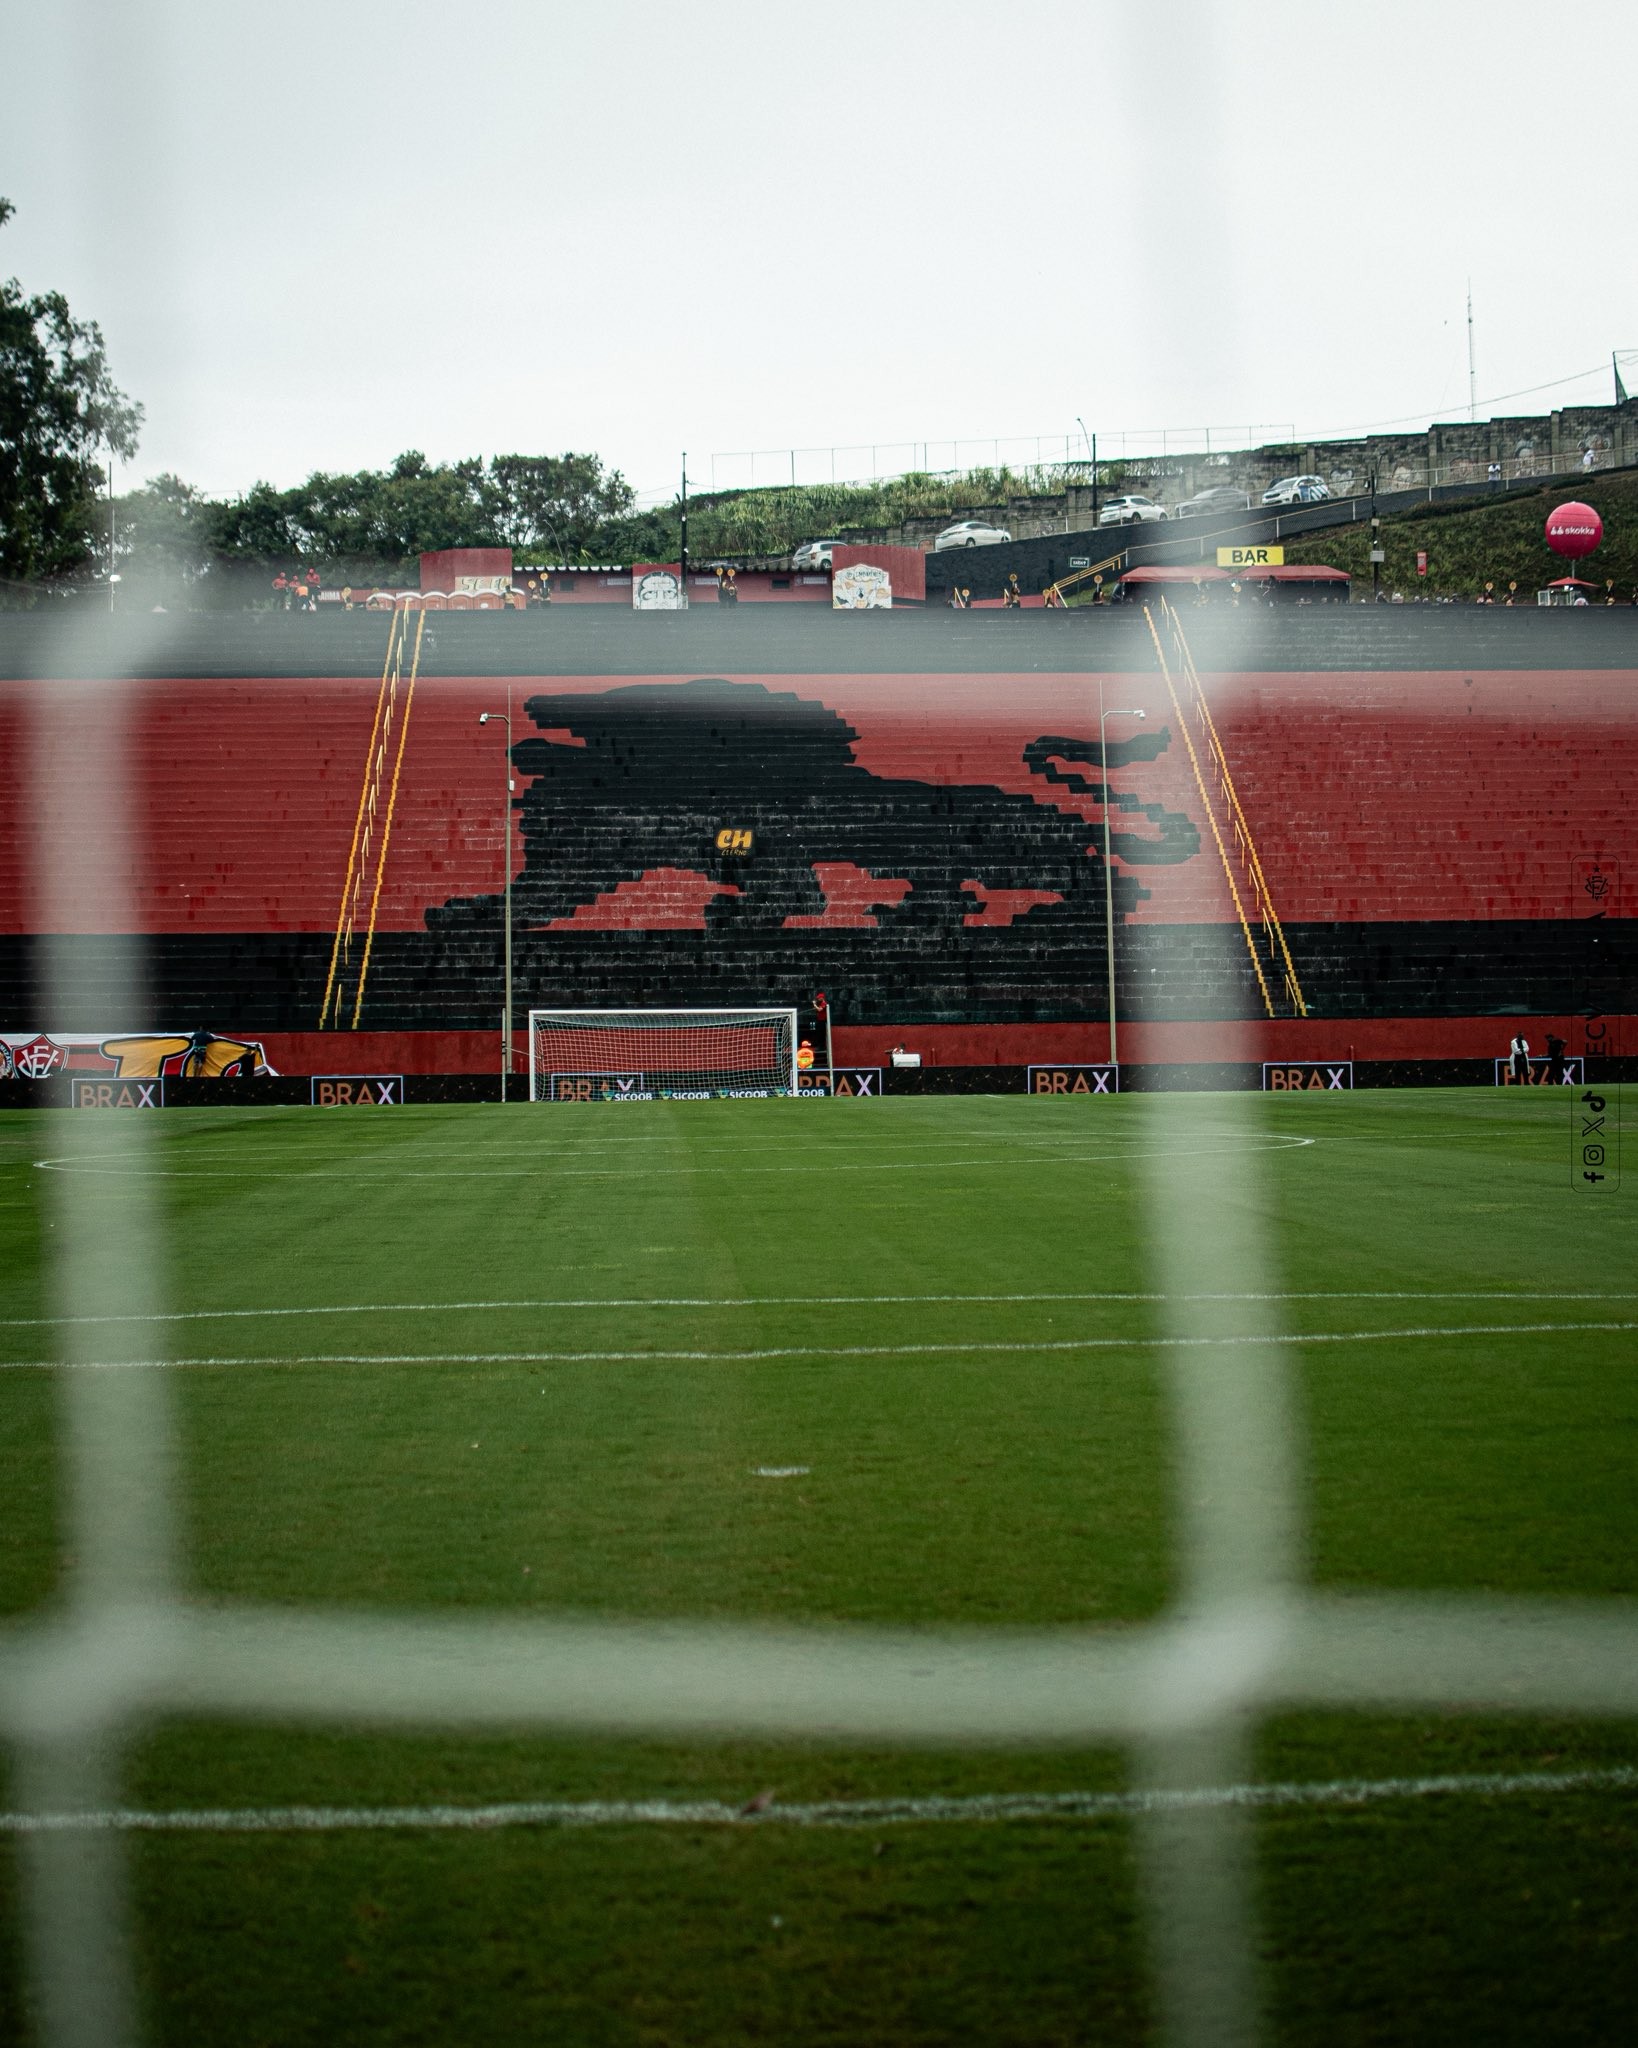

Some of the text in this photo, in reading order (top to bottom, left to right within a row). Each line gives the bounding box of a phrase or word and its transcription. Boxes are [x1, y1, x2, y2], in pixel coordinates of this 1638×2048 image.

[1565, 526, 1595, 536] skokka
[1232, 549, 1269, 563] BAR
[1036, 1071, 1110, 1094] BRAX
[1271, 1068, 1344, 1091] BRAX
[80, 1084, 155, 1108] BRAX
[320, 1082, 395, 1106] BRAX
[614, 1092, 653, 1102] SICOOB
[672, 1091, 710, 1100] SICOOB
[729, 1090, 768, 1099] SICOOB
[786, 1089, 825, 1098] SCOOB
